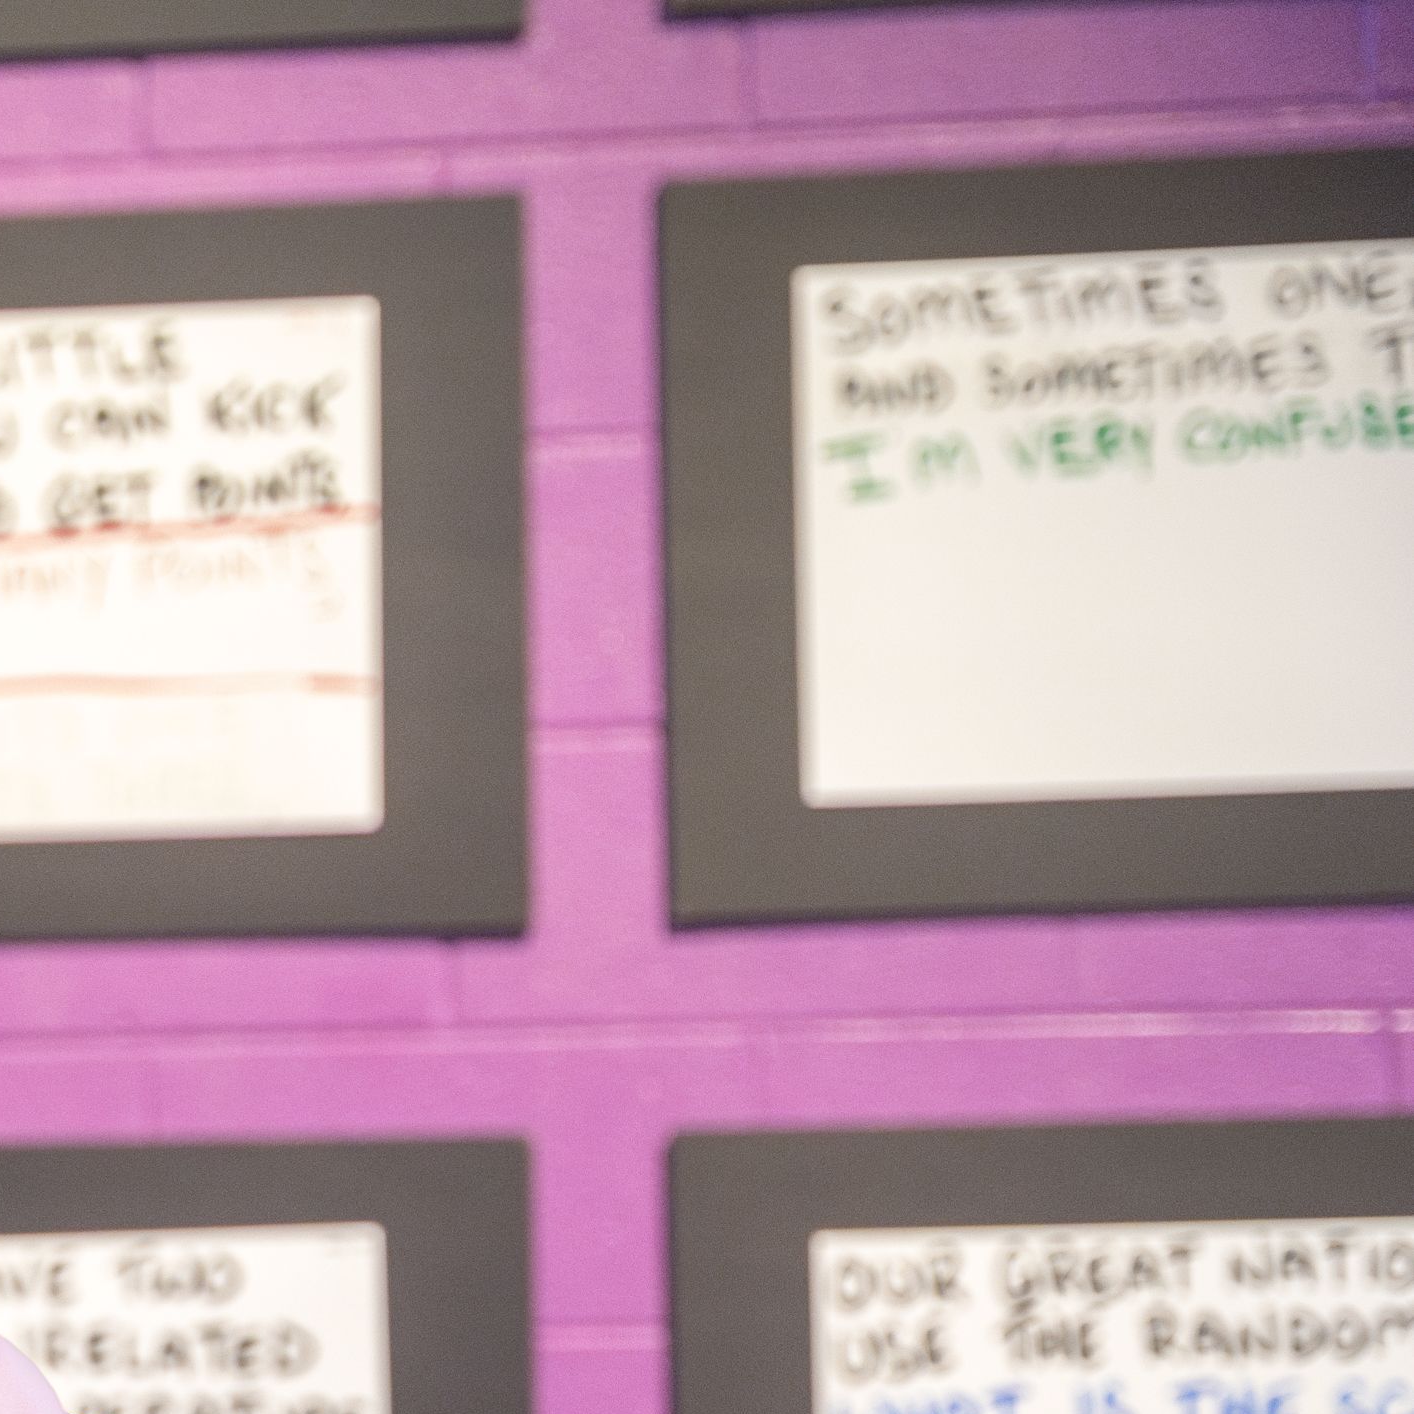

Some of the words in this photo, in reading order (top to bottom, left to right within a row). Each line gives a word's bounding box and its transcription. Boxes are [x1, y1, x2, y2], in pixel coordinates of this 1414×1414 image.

[820, 264, 1224, 354] SOMETIMES
[46, 396, 170, 450] CAN
[205, 372, 346, 435] KICK
[835, 357, 956, 418] AND
[979, 335, 1332, 412] SOMETIMES
[999, 413, 1157, 480] VERY
[44, 470, 157, 536] GET
[115, 1246, 248, 1306] TWO
[835, 1250, 966, 1313] OUR
[1003, 1240, 1204, 1312] GREAT
[22, 1316, 322, 1380] RELATED
[836, 1320, 952, 1386] USE
[1000, 1312, 1100, 1370] THE
